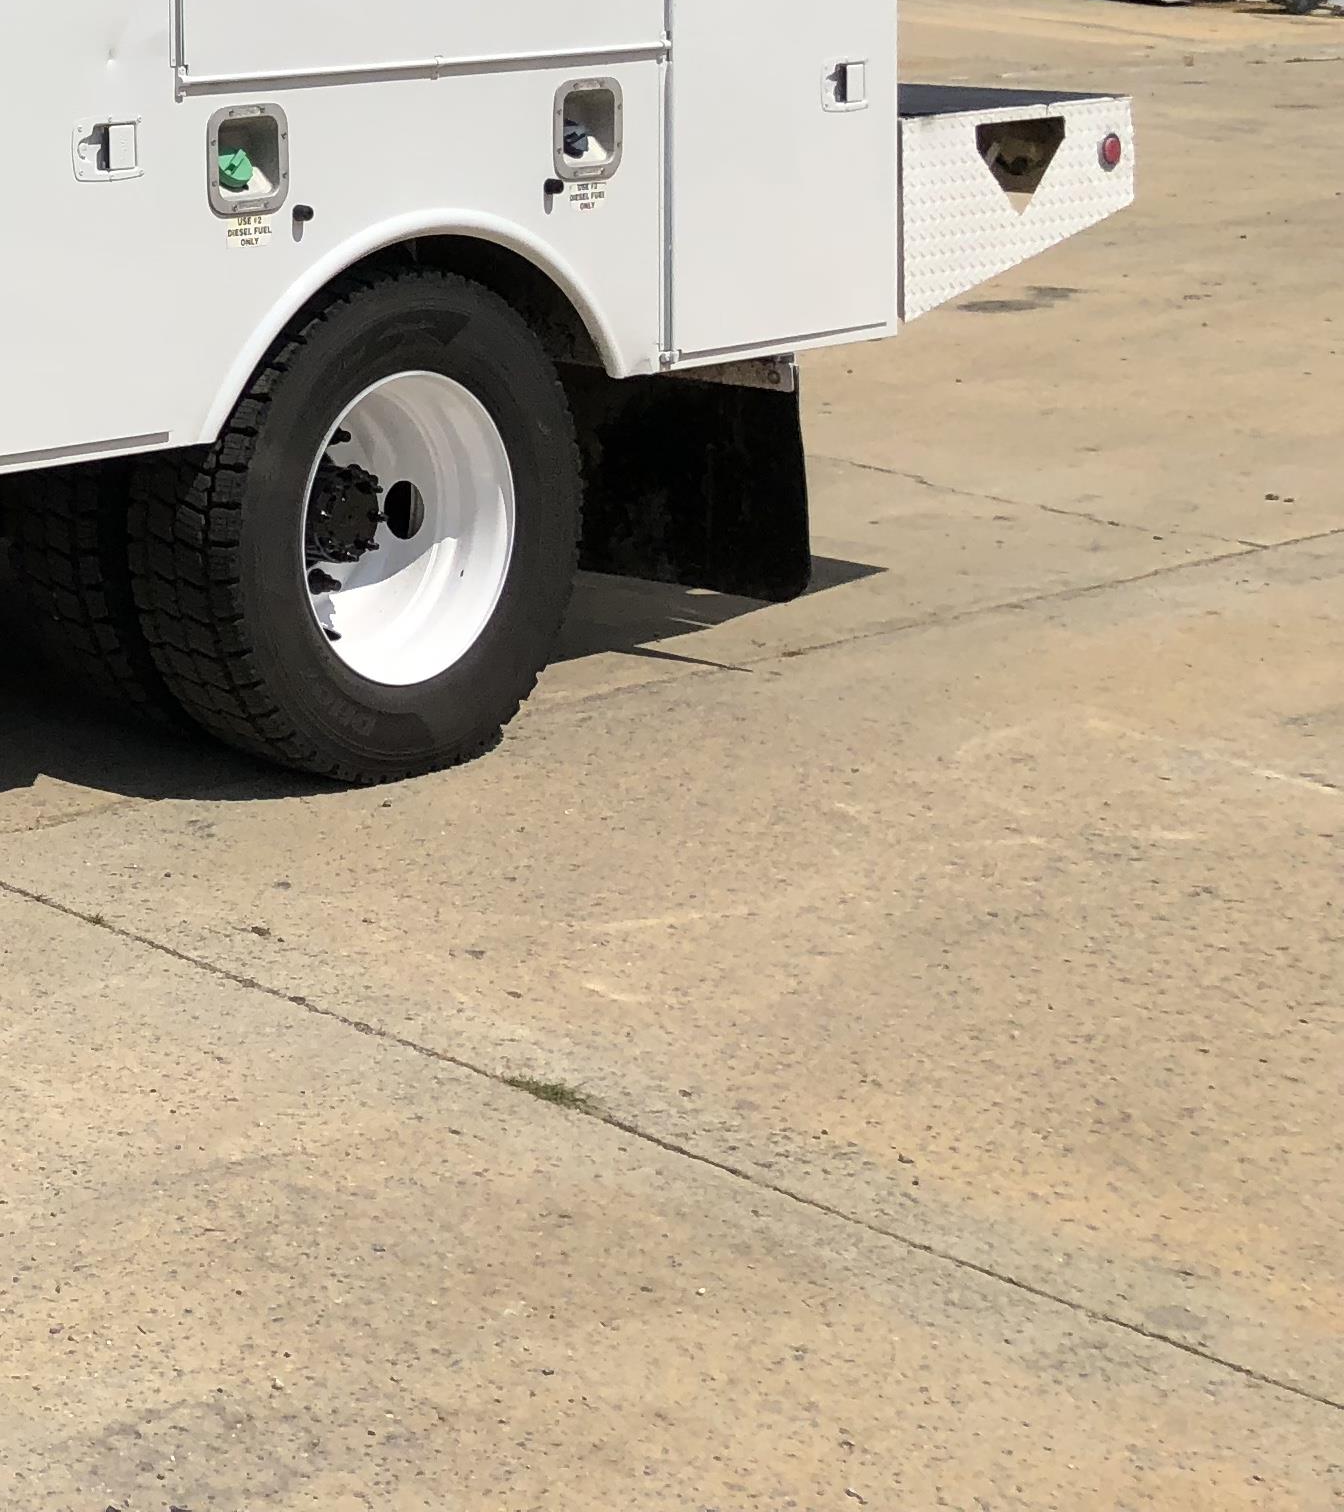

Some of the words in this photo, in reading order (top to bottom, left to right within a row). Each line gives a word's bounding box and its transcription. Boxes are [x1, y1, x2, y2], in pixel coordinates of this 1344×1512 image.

[237, 216, 252, 226] USE
[227, 227, 252, 237] DIESEL
[254, 226, 273, 235] FUEL
[240, 237, 259, 247] ONLY
